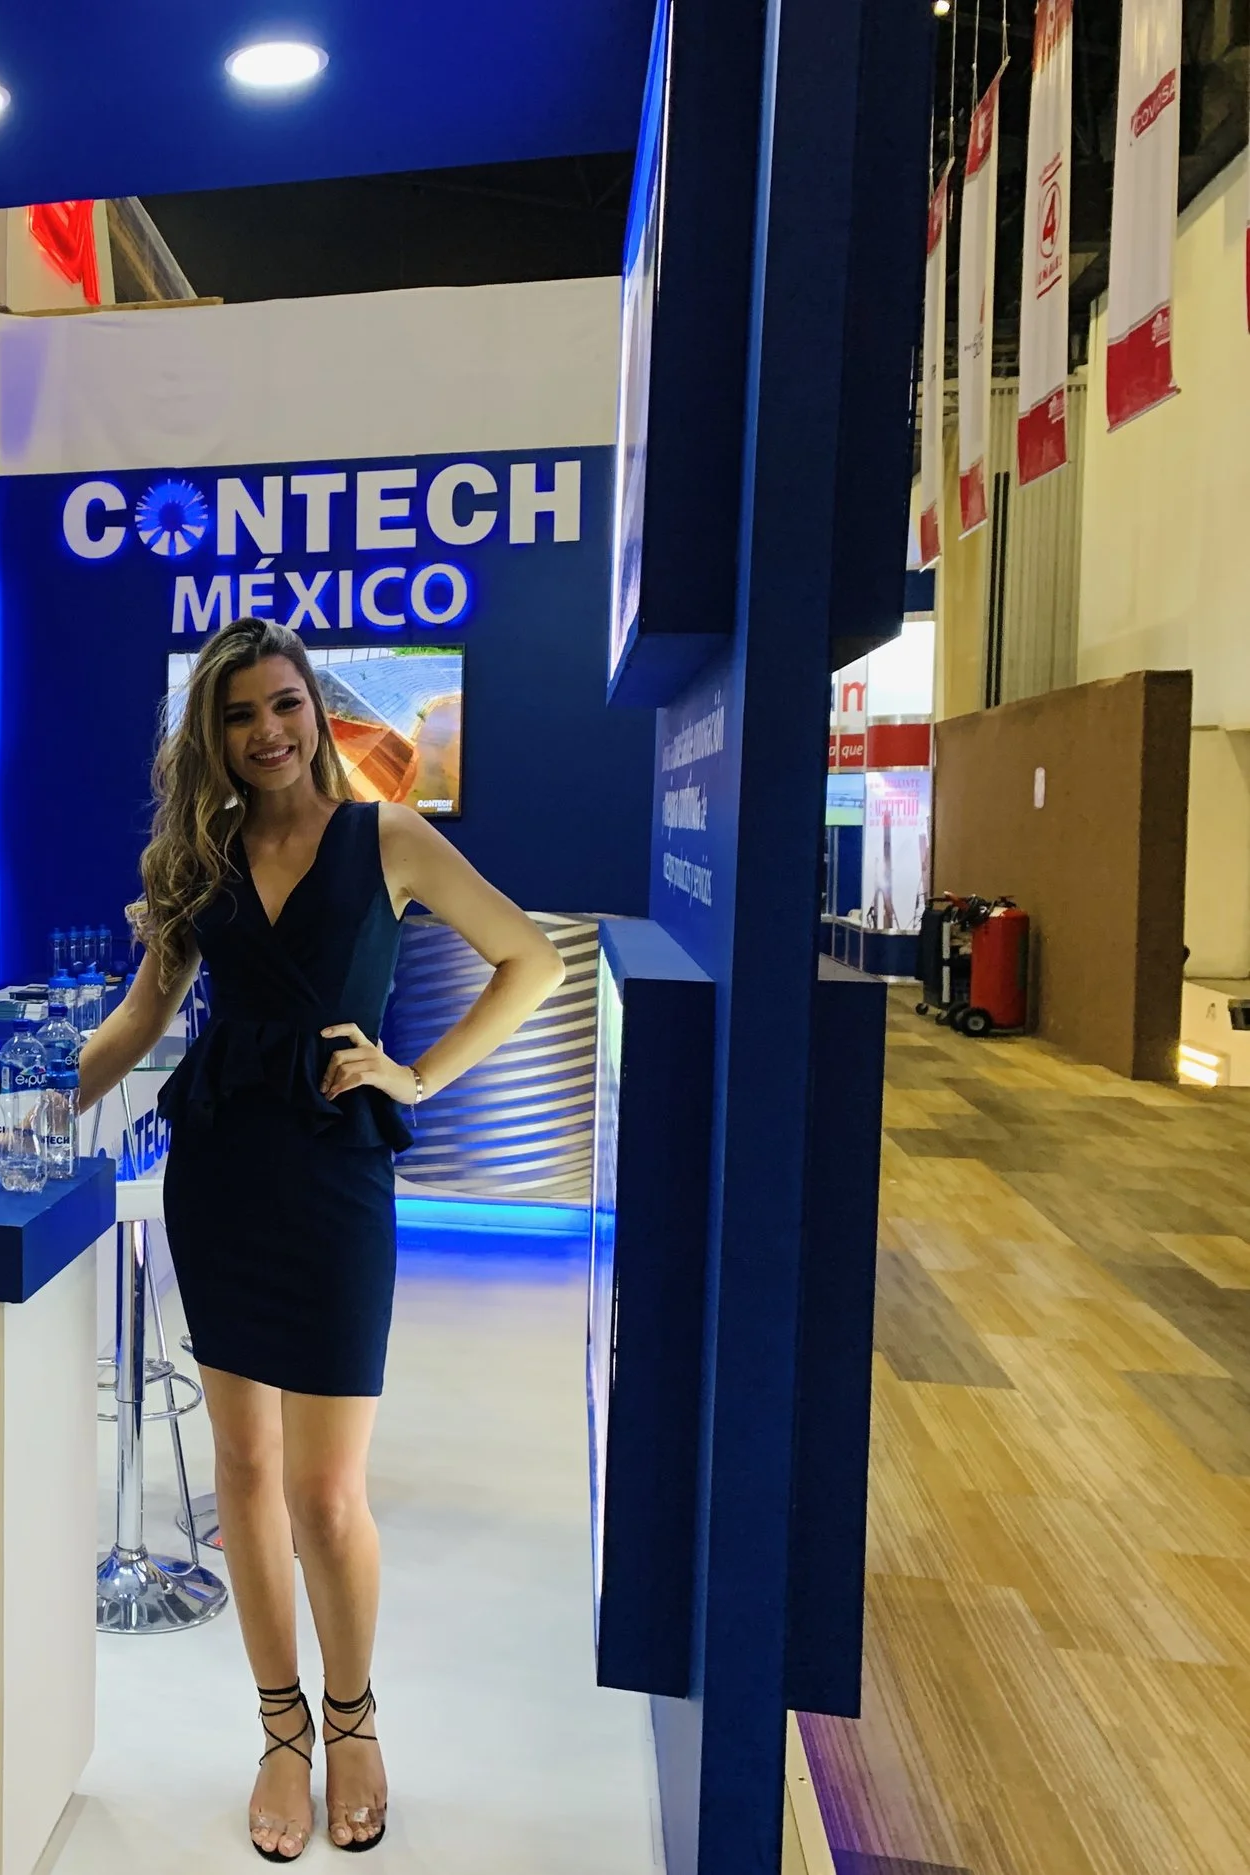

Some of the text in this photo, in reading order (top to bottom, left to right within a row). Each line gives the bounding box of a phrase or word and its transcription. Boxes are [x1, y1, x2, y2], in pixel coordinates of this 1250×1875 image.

[63, 460, 581, 559] CONTECH
[171, 558, 468, 635] MÉXICO
[842, 744, 863, 760] que
